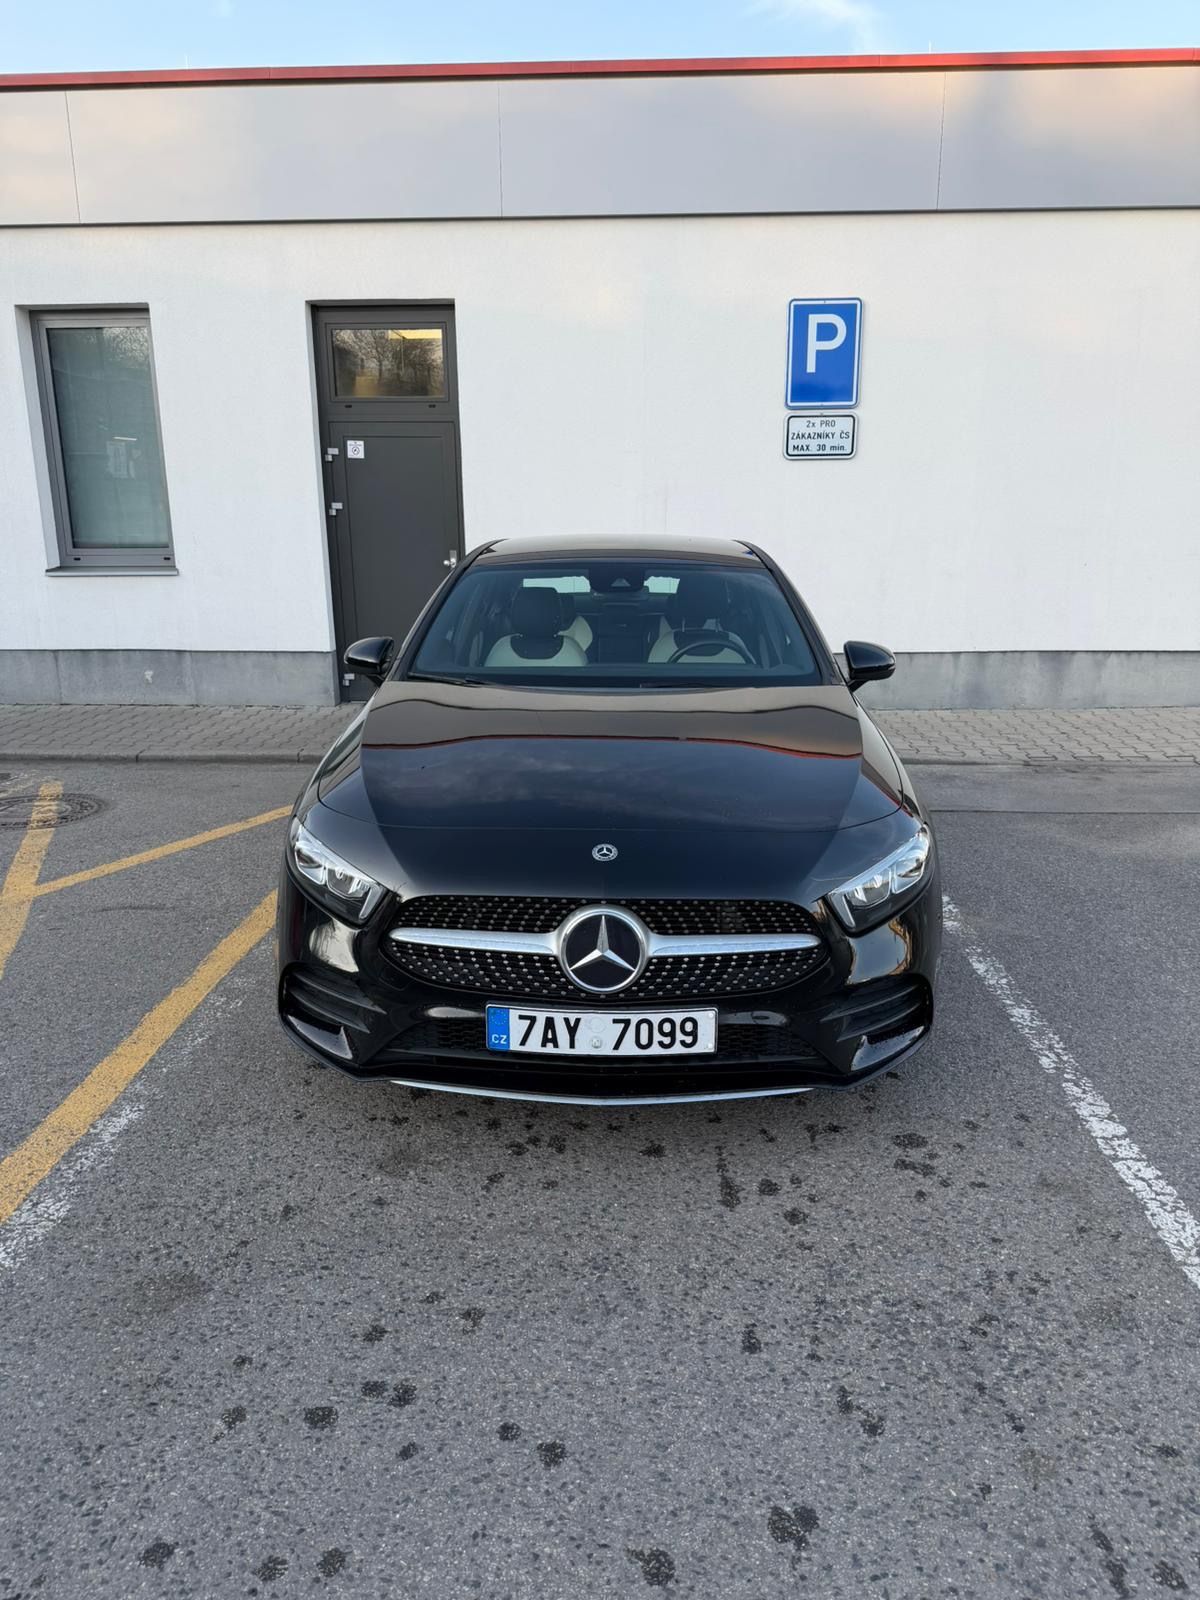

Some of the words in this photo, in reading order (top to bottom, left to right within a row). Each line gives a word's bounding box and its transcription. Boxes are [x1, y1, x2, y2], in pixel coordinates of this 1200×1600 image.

[806, 313, 847, 373] P
[806, 420, 816, 428] 2x
[820, 420, 836, 428] PRO
[791, 431, 836, 440] ZÁKAZNÍKY
[839, 430, 850, 440] ČS
[816, 444, 826, 452] 30
[830, 443, 847, 451] min.
[517, 1014, 582, 1050] 7AY
[612, 1017, 699, 1051] 7099
[491, 1033, 507, 1045] CZ
